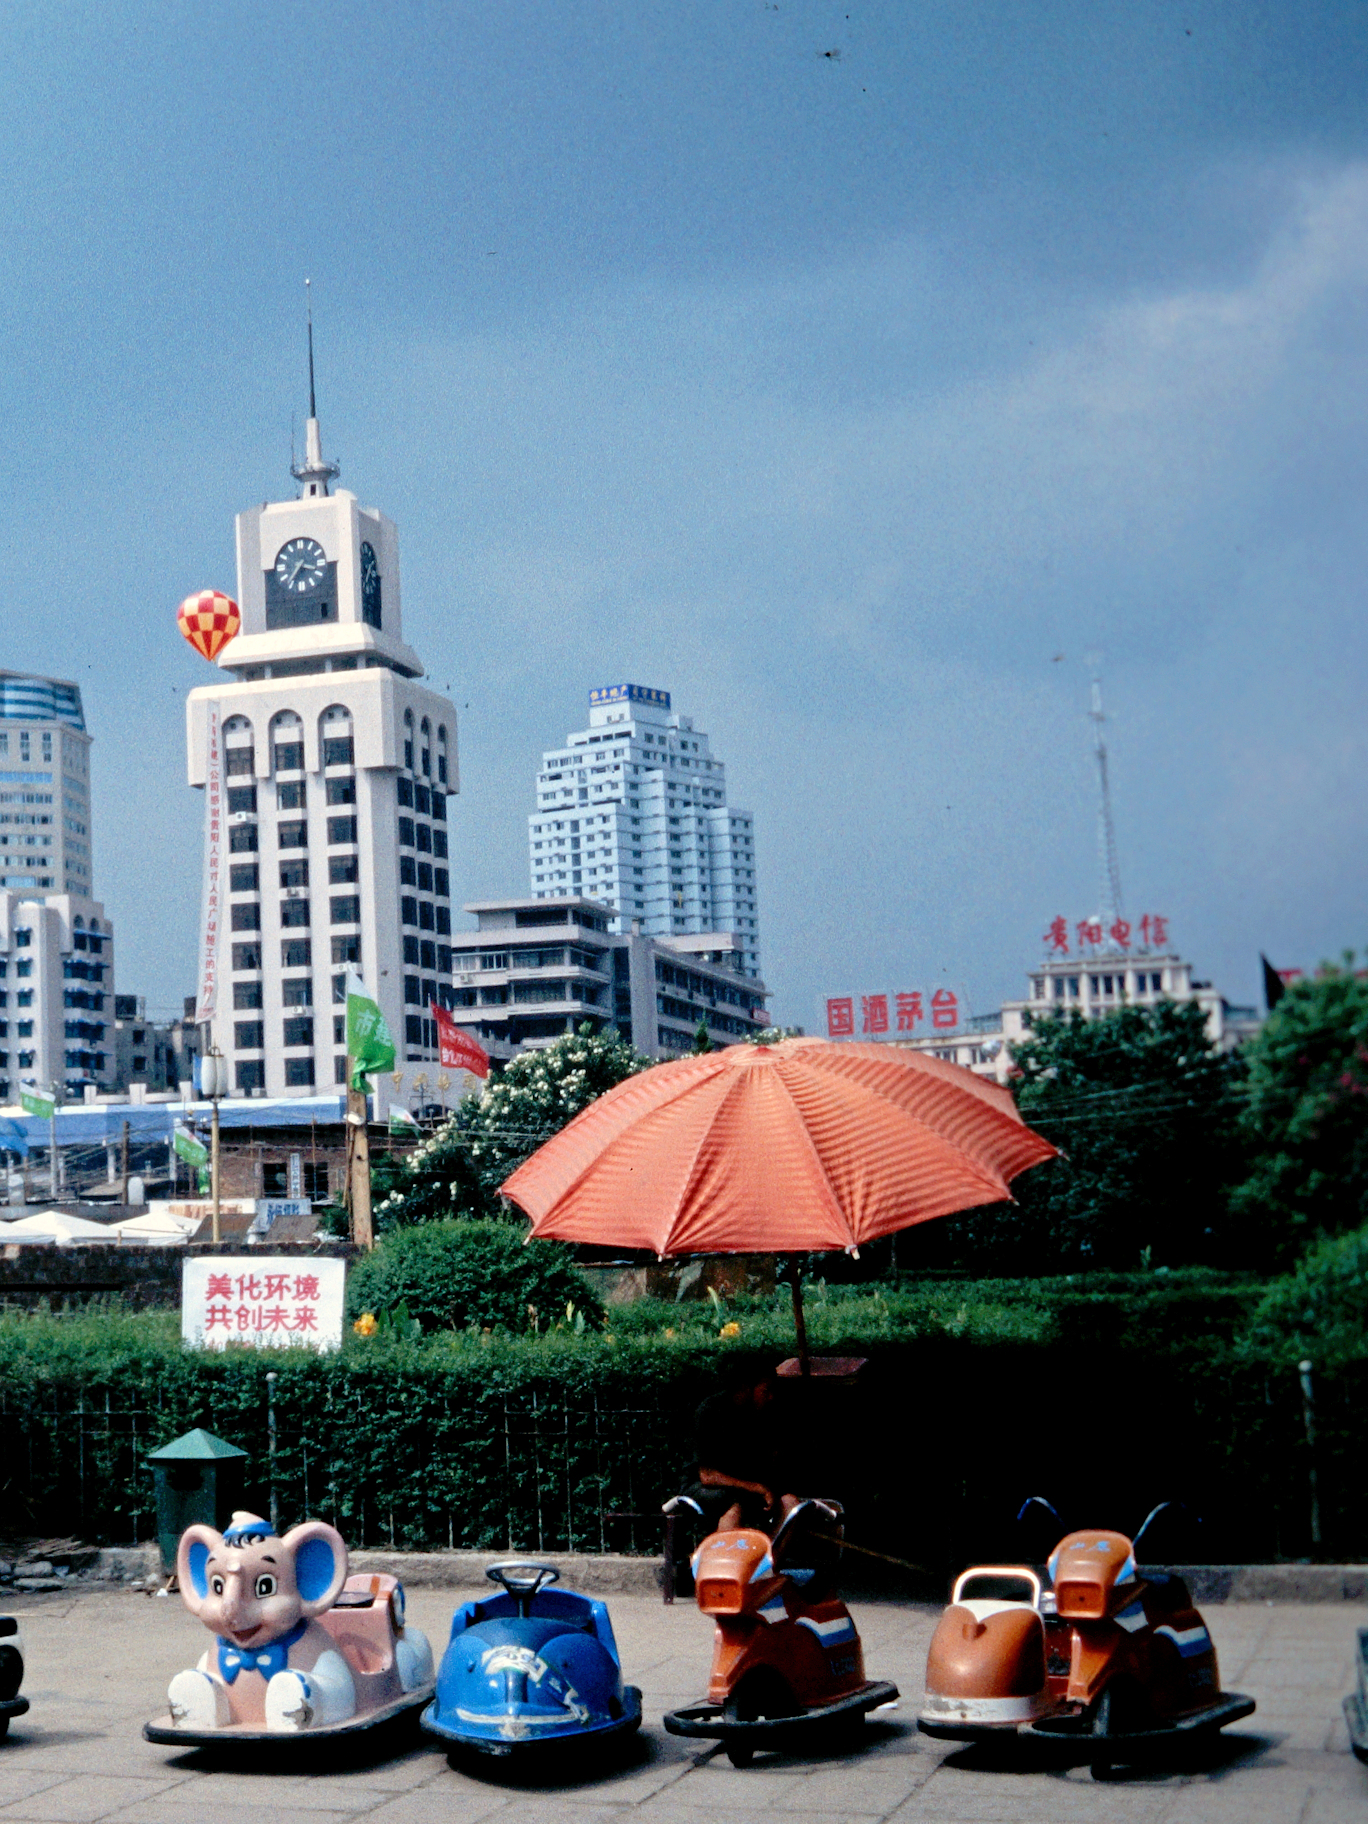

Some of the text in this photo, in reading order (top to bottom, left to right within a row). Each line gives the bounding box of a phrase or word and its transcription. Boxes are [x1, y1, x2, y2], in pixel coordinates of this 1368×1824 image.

[1043, 914, 1169, 952] 贵阳电信
[827, 988, 958, 1036] 国酒茅台
[205, 1273, 321, 1301] 美化环境
[205, 1304, 319, 1332] 共创未来
